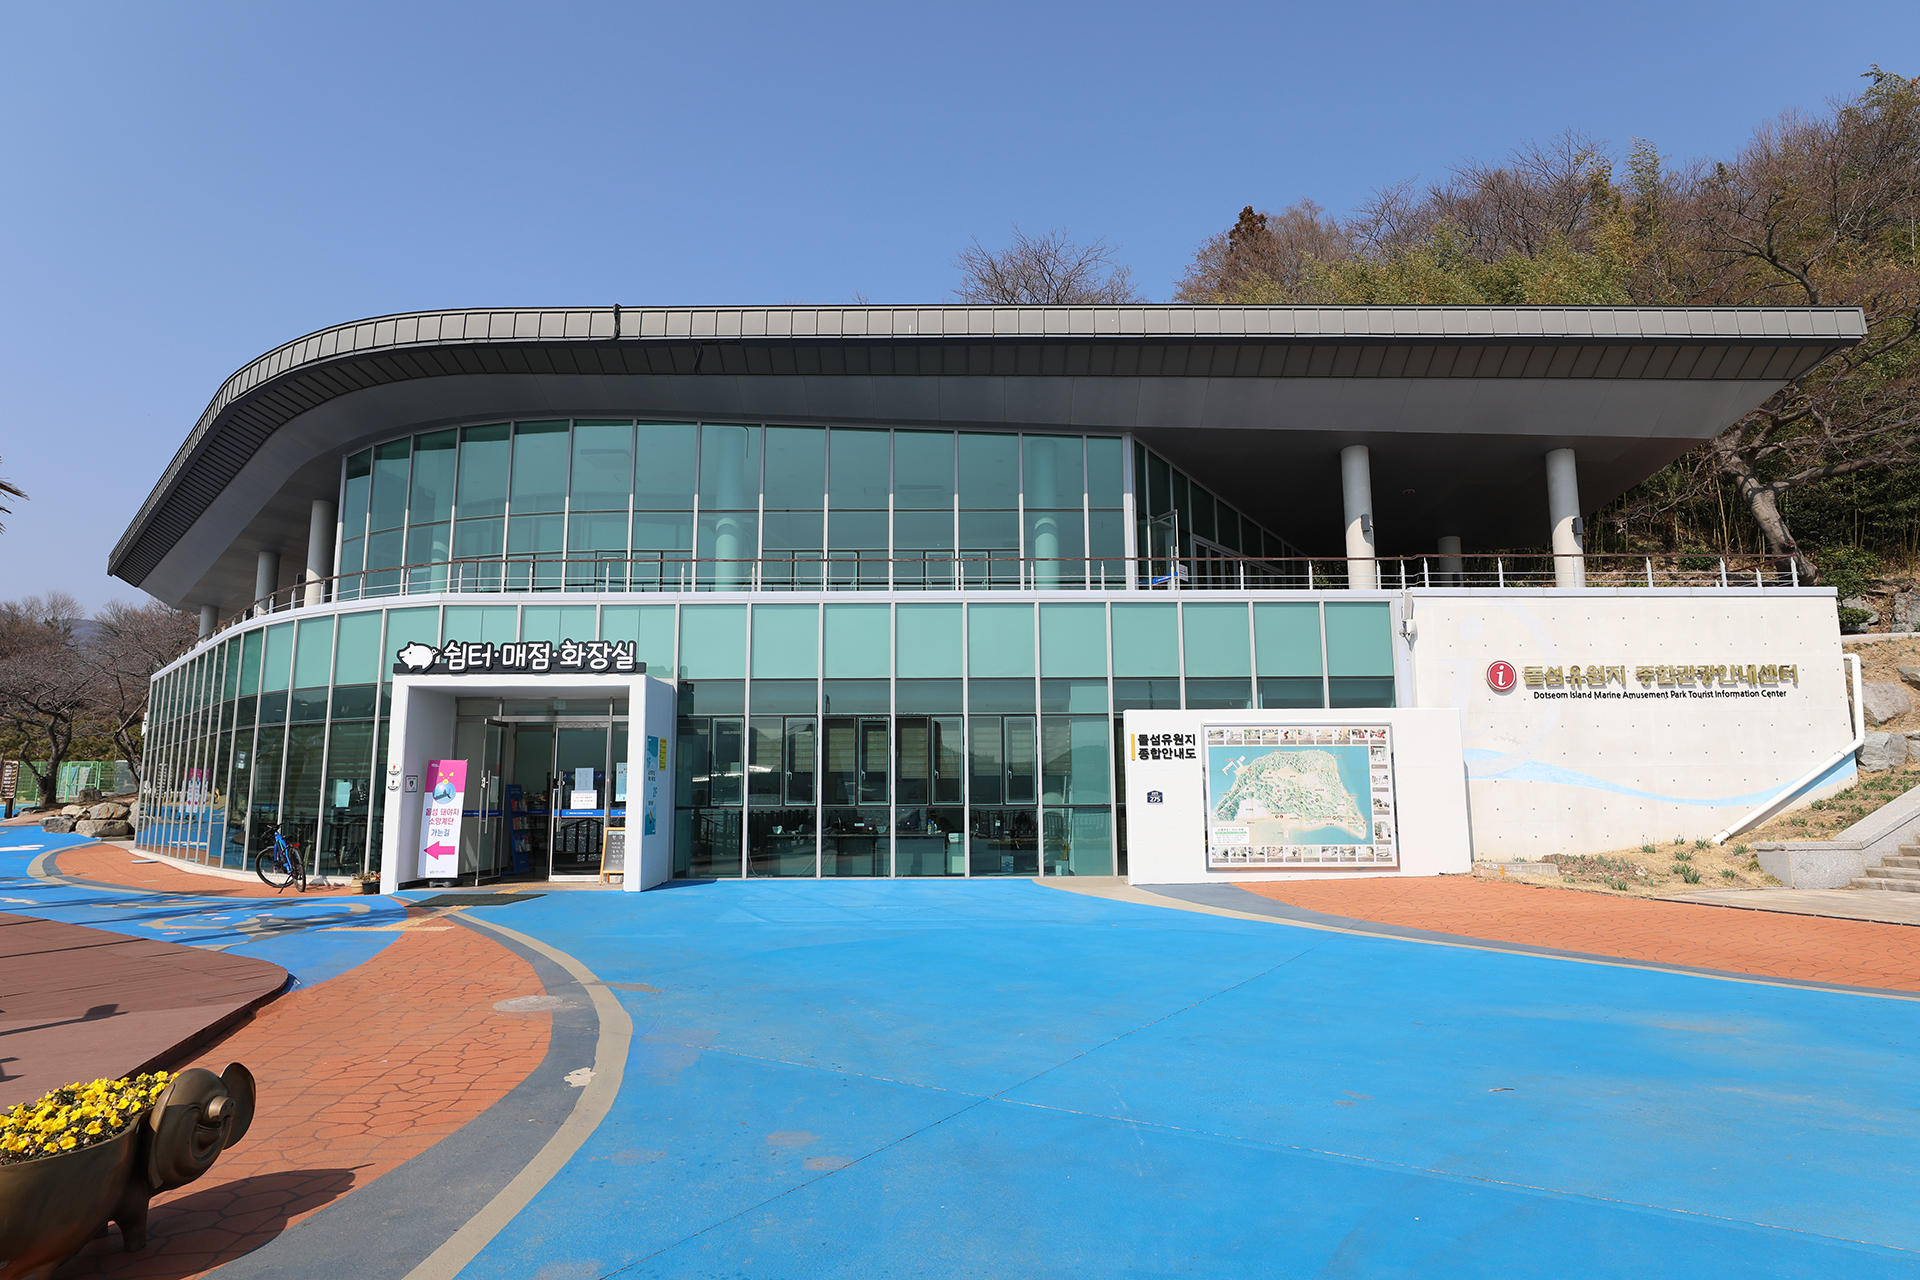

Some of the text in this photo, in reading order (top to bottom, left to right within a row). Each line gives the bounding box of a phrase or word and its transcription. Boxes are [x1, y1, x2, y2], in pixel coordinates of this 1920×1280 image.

[1635, 664, 1798, 686] 종합관광안내센터
[1533, 689, 1787, 700] Dotseom Island Marine Amusement Park Tourist Information Center
[1138, 747, 1197, 760] 종합안내도
